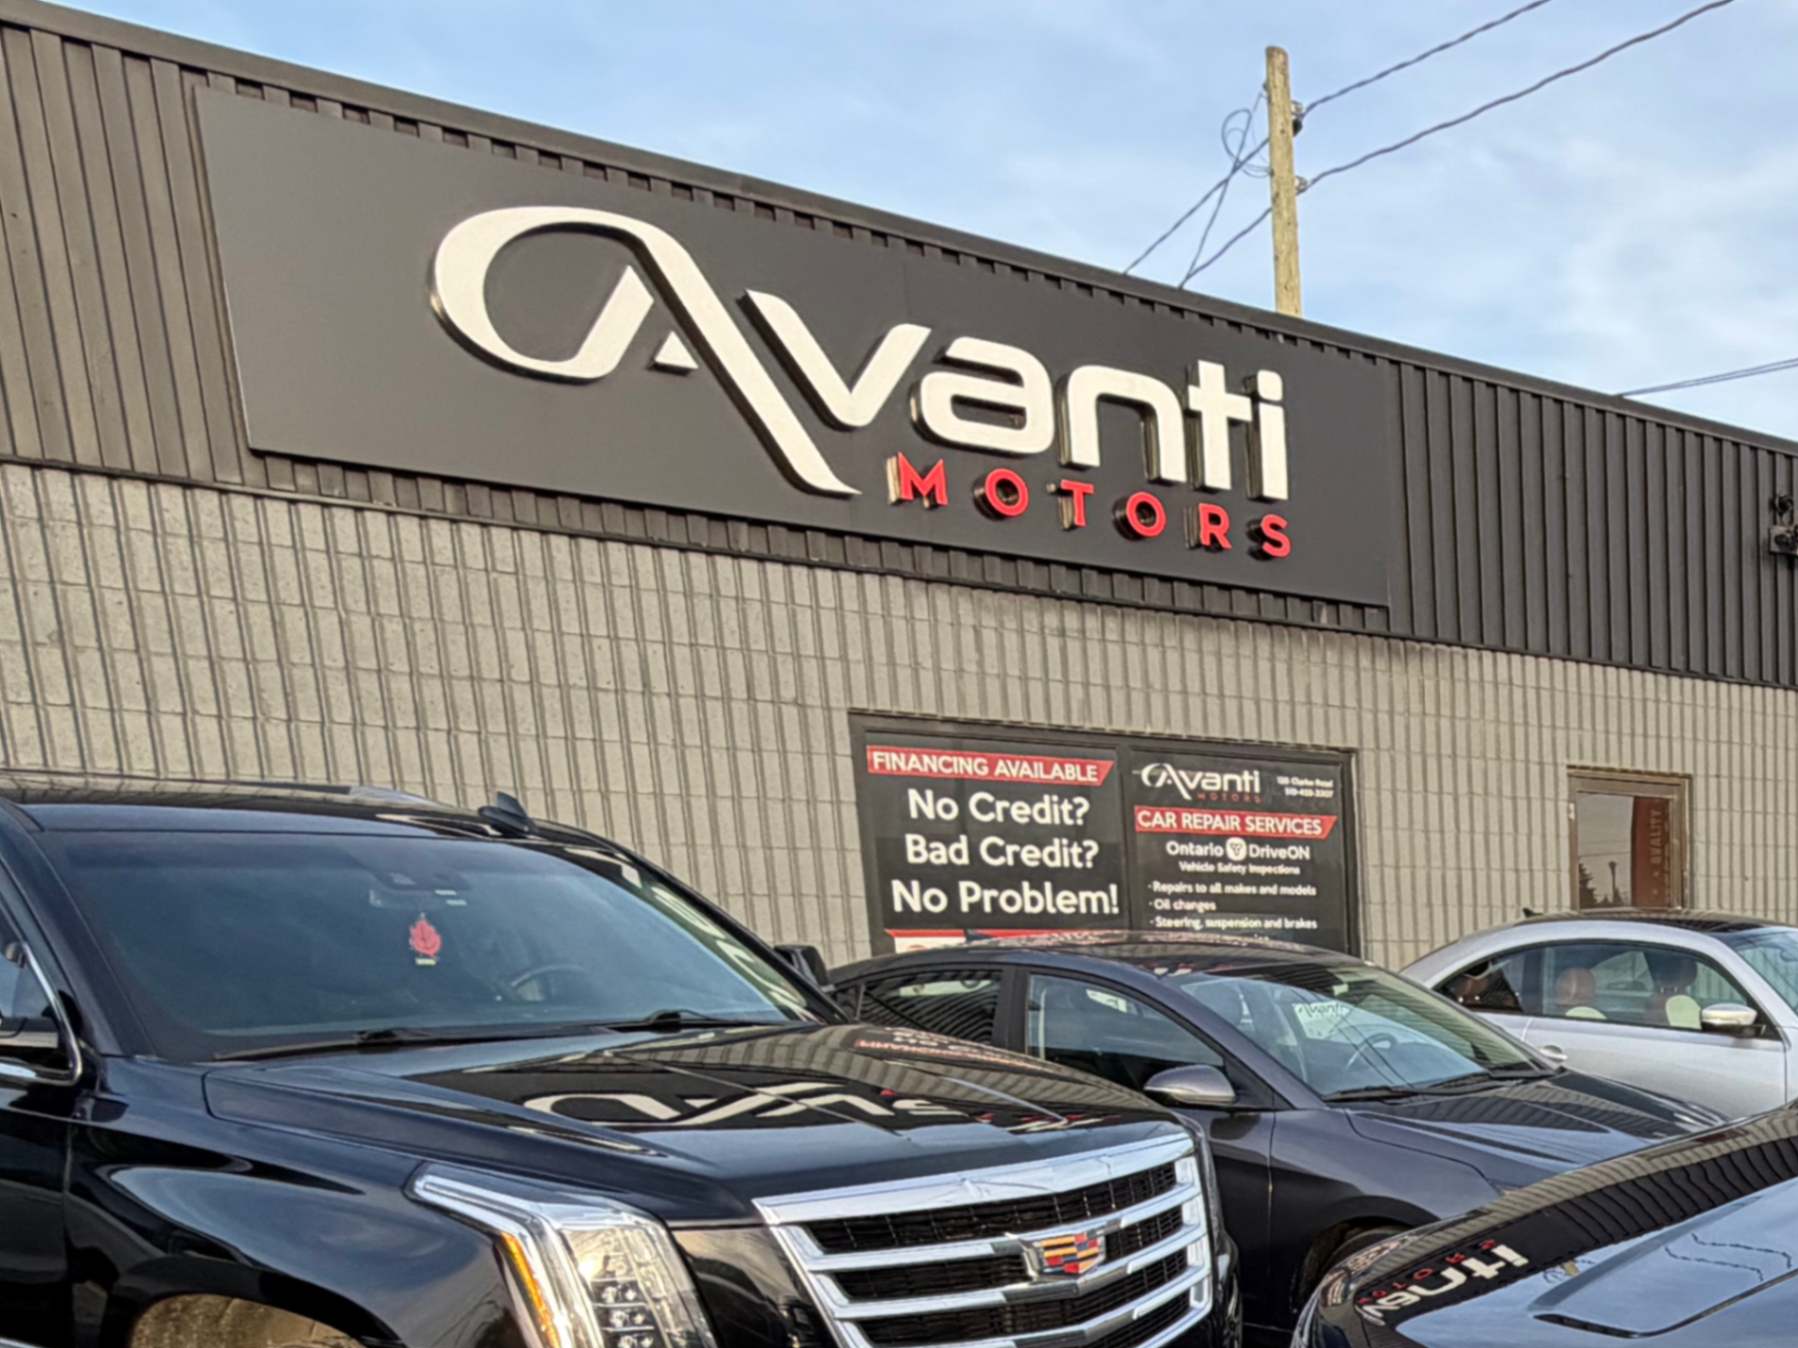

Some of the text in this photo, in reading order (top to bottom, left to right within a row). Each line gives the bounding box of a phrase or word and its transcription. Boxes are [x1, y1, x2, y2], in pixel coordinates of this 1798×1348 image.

[432, 205, 1289, 500] Avanti
[887, 452, 1292, 559] MOTORS
[872, 751, 1098, 782] FINANCING AVAILABLE
[1141, 763, 1260, 800] Avanti
[907, 788, 1090, 825] No Credit?
[1137, 811, 1322, 835] CAR REPAIR SERVICES
[905, 833, 1099, 869] Bad Credit?
[1165, 840, 1311, 861] Ontario DriveON
[1179, 861, 1301, 876] Vehicle Safety Inspections
[891, 879, 1120, 915] No Problem!
[1153, 881, 1317, 896] Repairs to all makes and models
[1154, 899, 1217, 913] Oil changes
[1205, 918, 1263, 930] suspension
[1264, 918, 1283, 928] and
[1284, 918, 1318, 929] brakes
